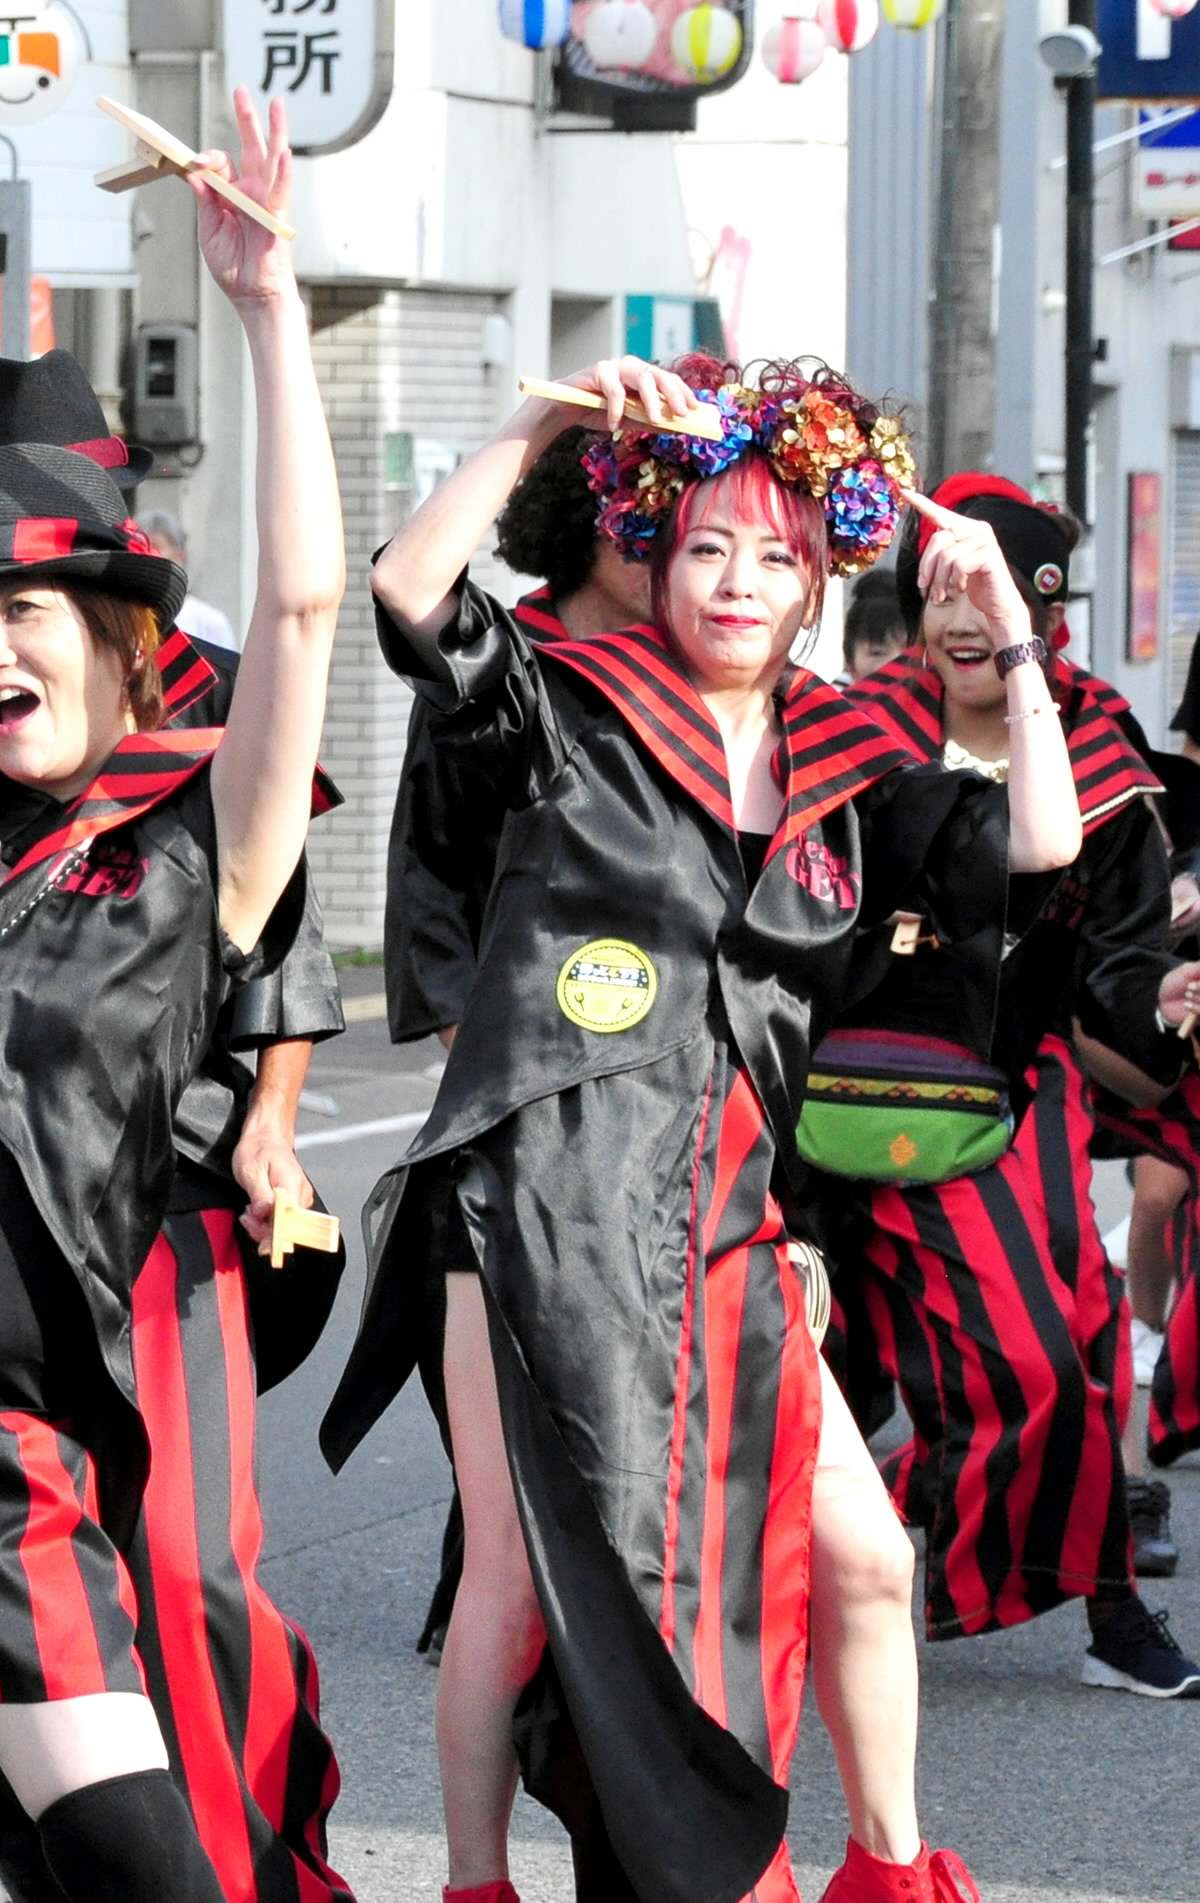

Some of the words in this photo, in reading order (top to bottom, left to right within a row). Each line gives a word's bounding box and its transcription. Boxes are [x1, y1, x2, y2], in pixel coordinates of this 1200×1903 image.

[261, 0, 340, 93] 所
[47, 851, 149, 899] GET
[784, 848, 861, 909] GET
